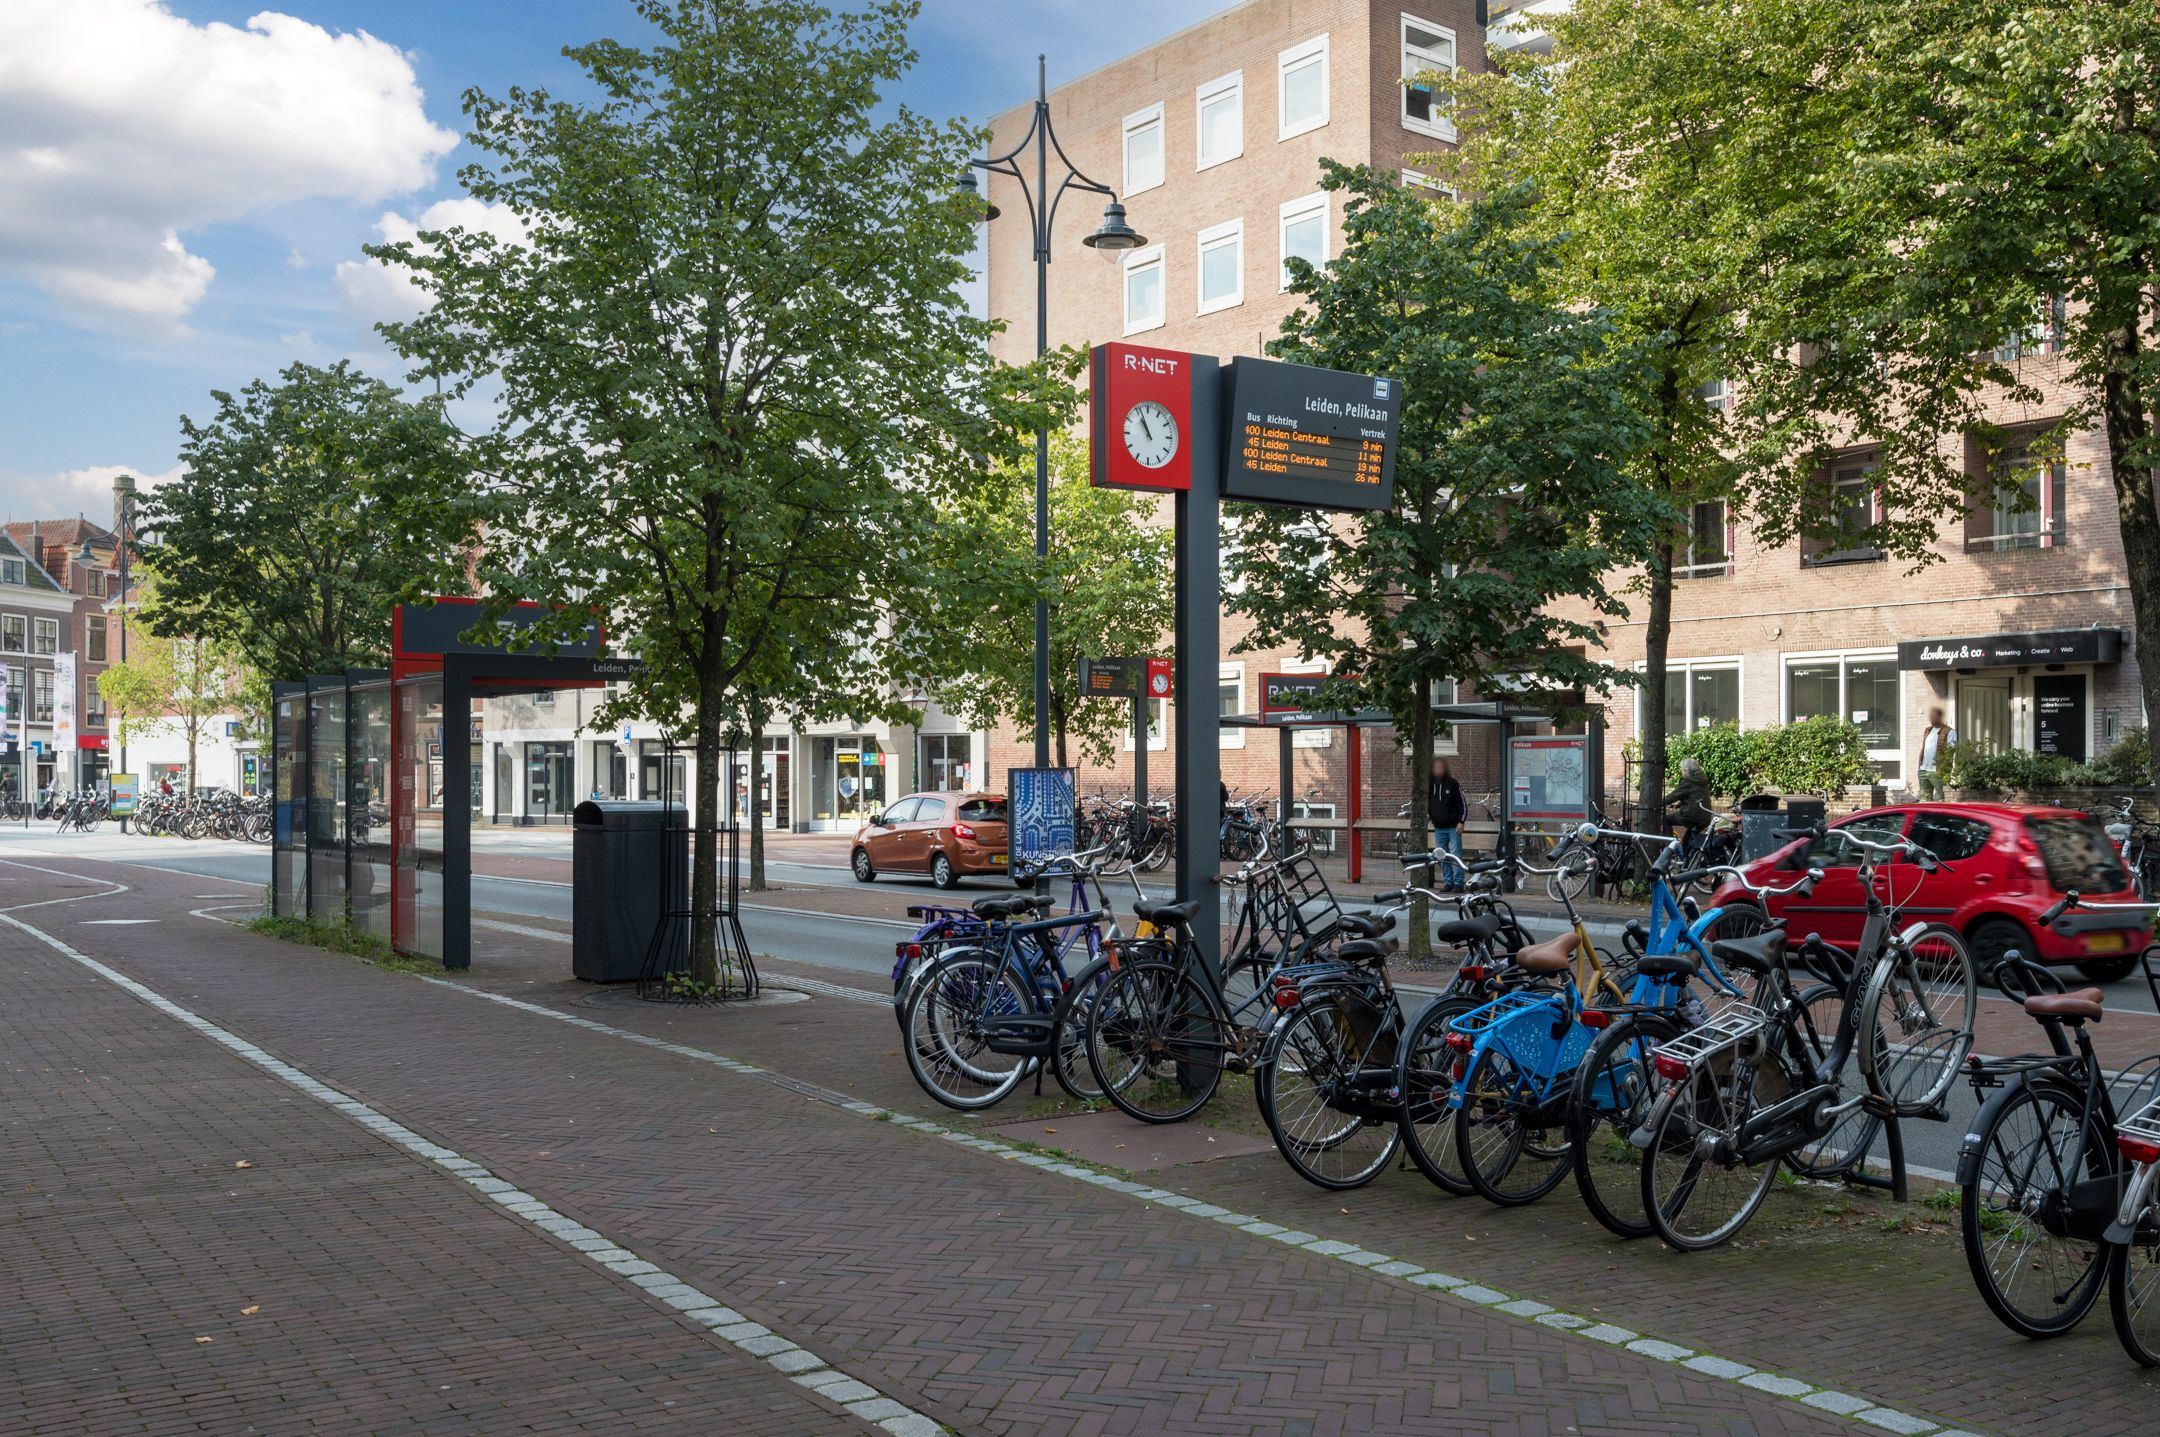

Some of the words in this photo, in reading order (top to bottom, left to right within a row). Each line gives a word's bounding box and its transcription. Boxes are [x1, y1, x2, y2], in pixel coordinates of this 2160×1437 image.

[1305, 396, 1343, 418] Leiden,
[1345, 402, 1388, 422] Pelikaan
[1247, 412, 1261, 422] Bus
[1266, 414, 1298, 429] Richting
[1245, 425, 1260, 436] 400
[1262, 427, 1289, 439] Leiden
[1292, 431, 1330, 445] Centraal
[1363, 440, 1369, 450] 9
[1370, 442, 1383, 452] min
[1360, 427, 1386, 439] Vertrek
[1248, 437, 1259, 447] 45
[1261, 438, 1289, 451] Leiden
[1359, 451, 1368, 461] 11
[1369, 453, 1382, 463] min
[1243, 447, 1259, 458] 400
[1260, 449, 1288, 462] Leiden
[1290, 453, 1329, 467] Centraal
[1358, 462, 1367, 472] 19
[1368, 464, 1381, 474] min
[1246, 459, 1258, 469] 45
[1259, 461, 1287, 473] Leiden
[1355, 472, 1366, 483] 26
[1367, 474, 1380, 484] min
[1920, 645, 1960, 665] donkeys
[1960, 645, 1969, 658] &
[2030, 647, 2051, 655] Creatie
[593, 663, 627, 675] Leiden,
[2041, 720, 2047, 729] 5
